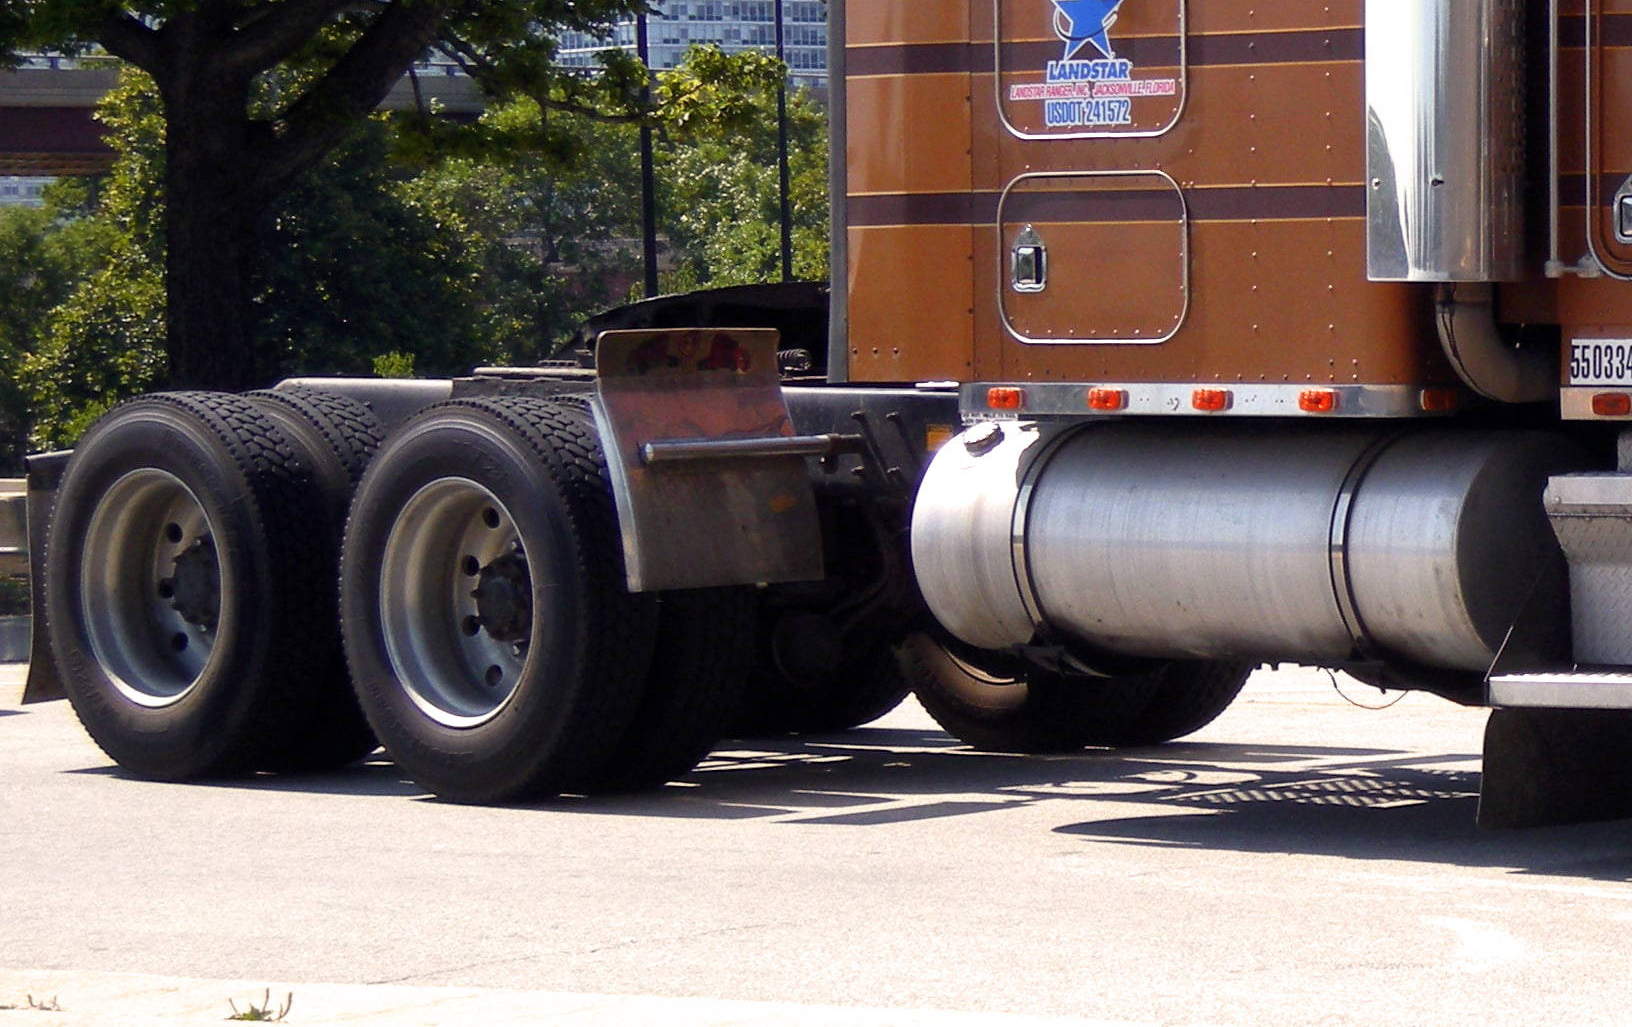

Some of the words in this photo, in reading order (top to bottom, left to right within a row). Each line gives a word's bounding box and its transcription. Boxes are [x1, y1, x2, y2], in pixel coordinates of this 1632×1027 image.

[1049, 61, 1129, 80] LANDSTAR
[1047, 101, 1083, 124] USDOT
[1086, 100, 1130, 123] 241572
